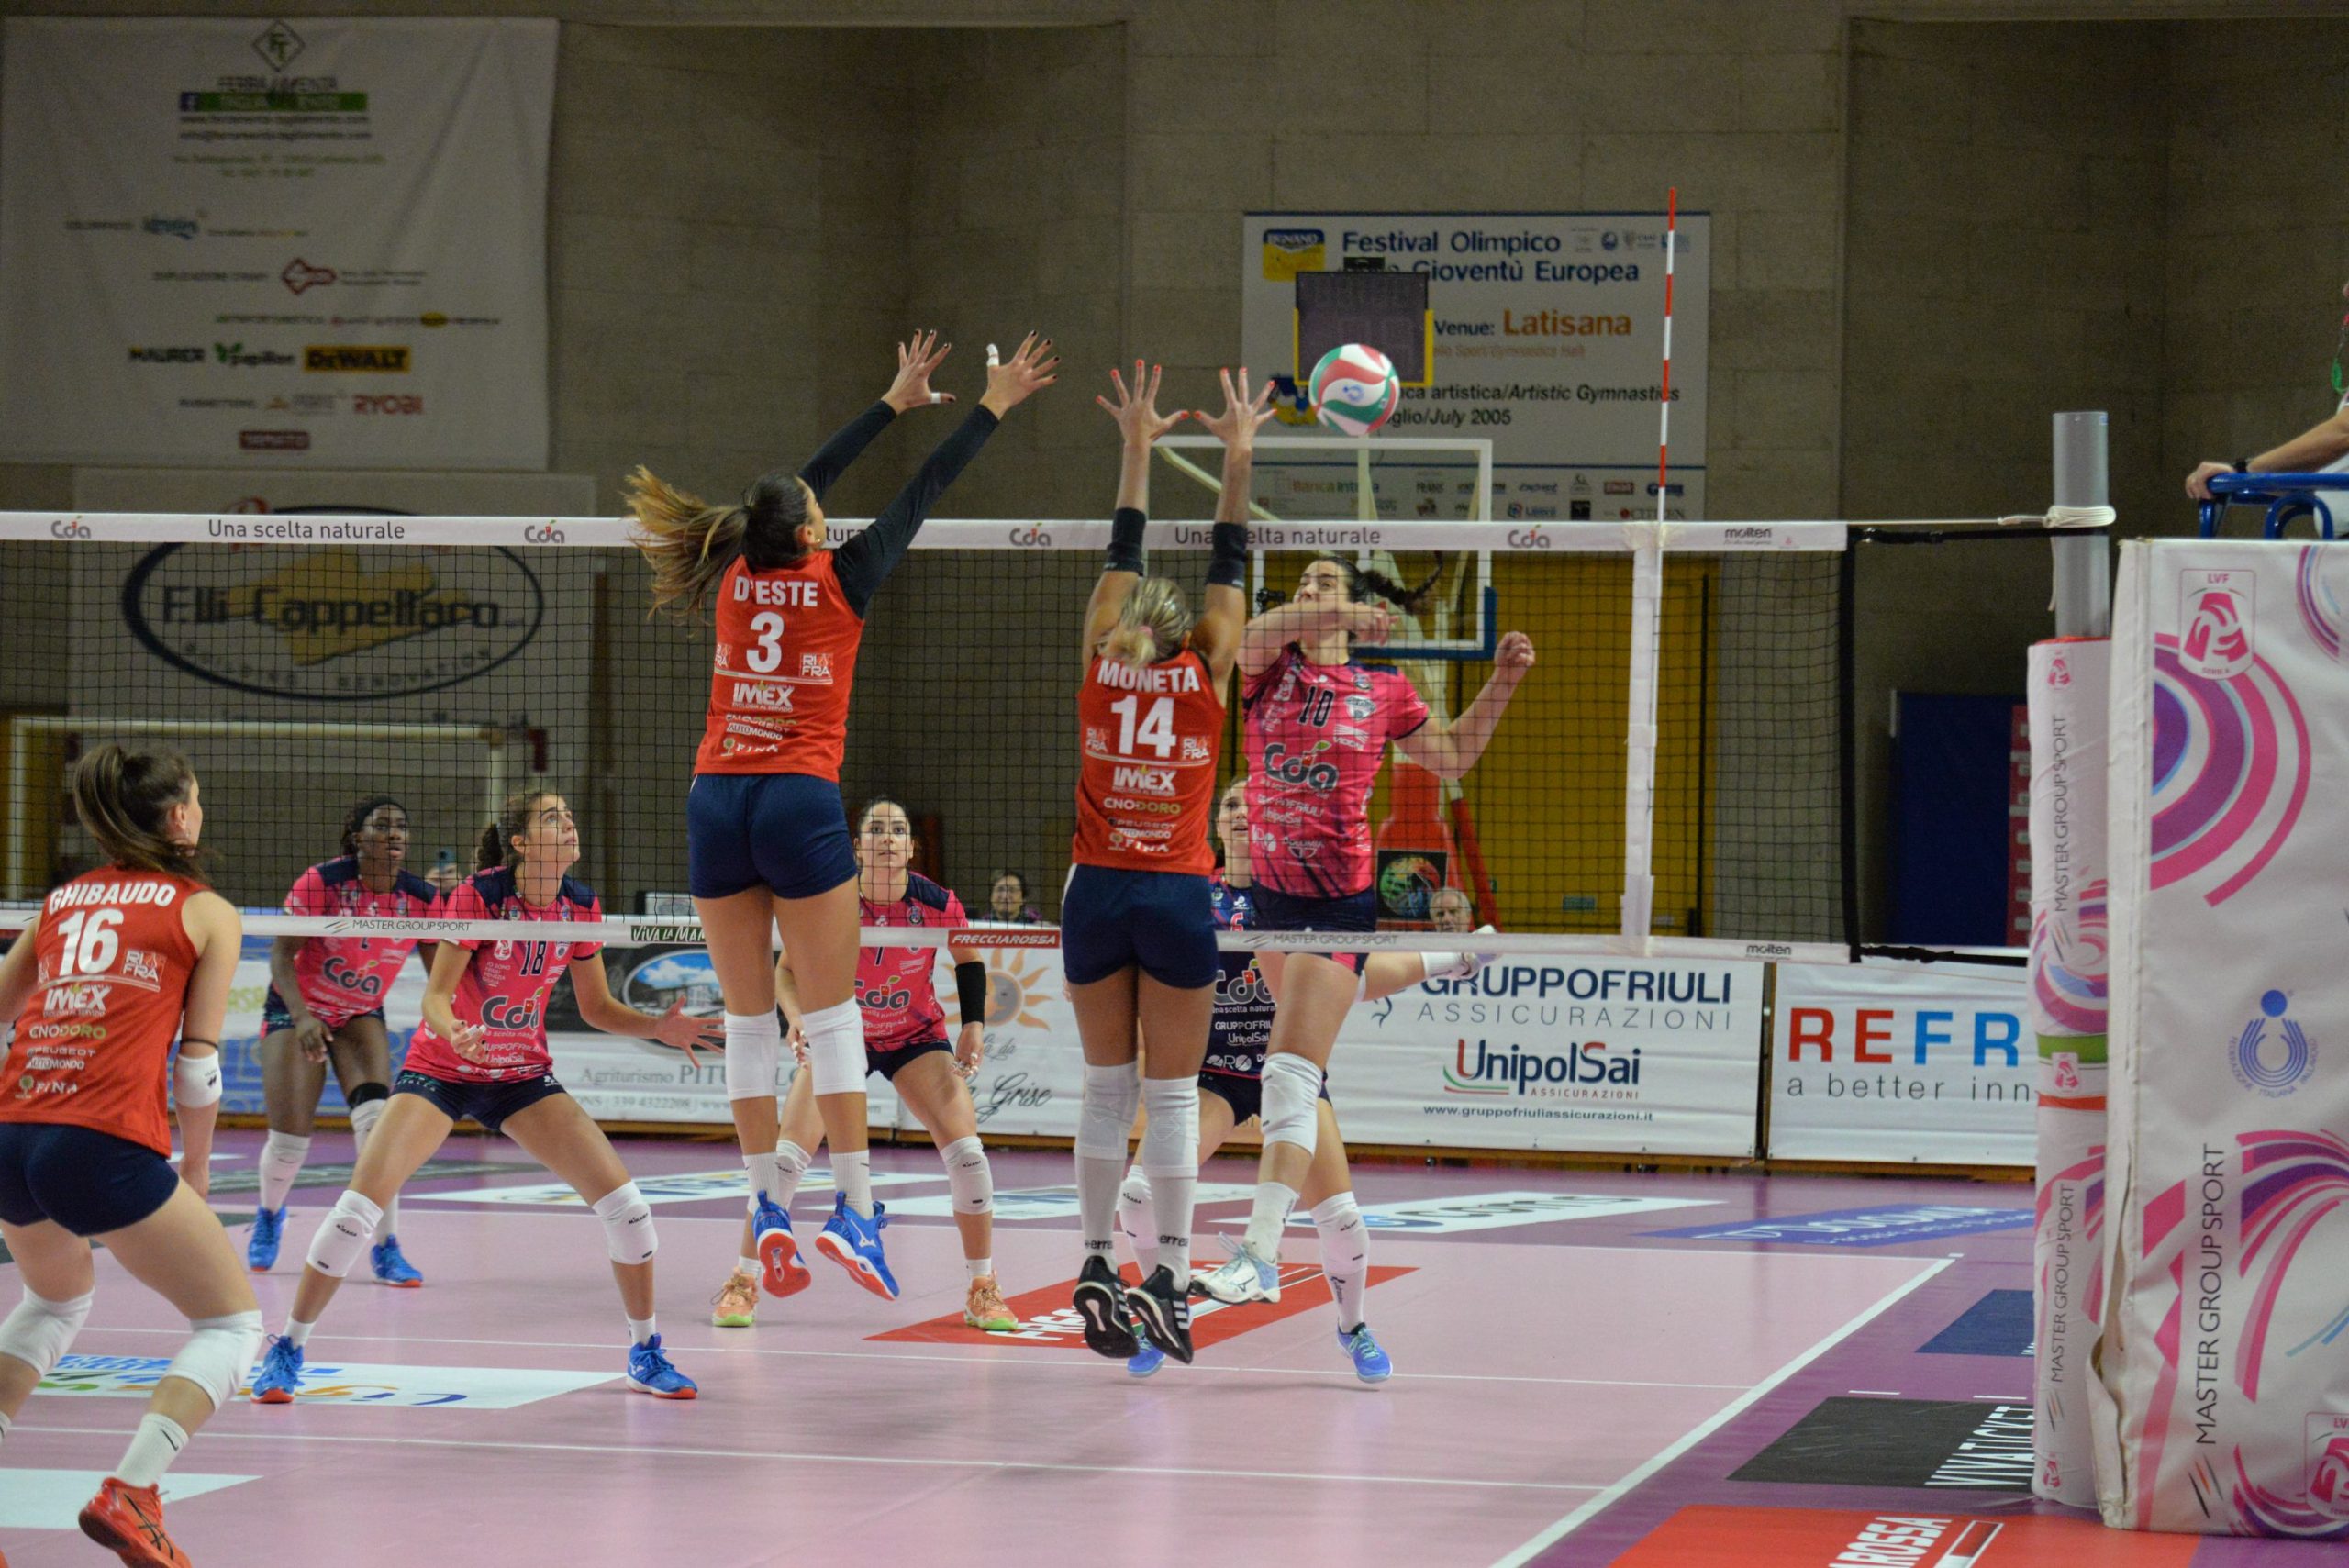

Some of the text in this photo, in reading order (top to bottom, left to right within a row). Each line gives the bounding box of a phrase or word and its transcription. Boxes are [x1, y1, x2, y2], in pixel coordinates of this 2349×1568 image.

[1342, 232, 1438, 253] Festival
[1451, 232, 1562, 258] Olimpico
[1535, 261, 1640, 285] Europea
[1434, 309, 1632, 337] Venue: Latisana
[1576, 384, 1680, 405] Gymnastis
[1471, 410, 1512, 426] 2005
[51, 517, 91, 539] Cda
[209, 521, 406, 539] Una scelta naturale
[524, 520, 565, 544] Cda
[1009, 523, 1051, 547] Cda
[1175, 527, 1381, 545] Una elta naturale
[1508, 525, 1550, 549] Cda
[1725, 528, 1772, 539] molten
[734, 576, 818, 606] D'ESTE
[2208, 573, 2229, 589] LVF
[254, 585, 500, 635] Cappellaro
[747, 611, 785, 673] 3
[1097, 660, 1200, 694] MONETA
[734, 682, 795, 708] IMEX
[1298, 685, 1335, 728] 10
[1111, 695, 1176, 758] 14
[1113, 767, 1177, 793] IMEX
[2054, 842, 2069, 913] MASTER
[49, 881, 177, 916] GHIBAUDO
[352, 919, 395, 929] MASTER
[58, 908, 125, 977] 16
[952, 934, 1056, 946] FRECCIAROSSA
[1273, 935, 1318, 944] MASTER
[1745, 943, 1791, 956] molten
[45, 984, 112, 1012] IMEX
[1420, 966, 1731, 1005] GRUPPOFRIULI
[1418, 1003, 1731, 1031] ASSICURAZIONI
[1788, 1007, 2021, 1067] REFR
[583, 1068, 673, 1086] Agriturismo
[1457, 1039, 1641, 1096] UnipolSai
[1531, 1088, 1641, 1100] ASSICURAZIONI
[1787, 1073, 2031, 1102] a better inn
[1423, 1106, 1653, 1122] www.gruppofriuliassicurazioni.it
[2196, 1143, 2226, 1445] MASTER GROUP SPORT
[2052, 1312, 2067, 1383] MASTER
[1925, 1406, 2036, 1487] VIVATICKET
